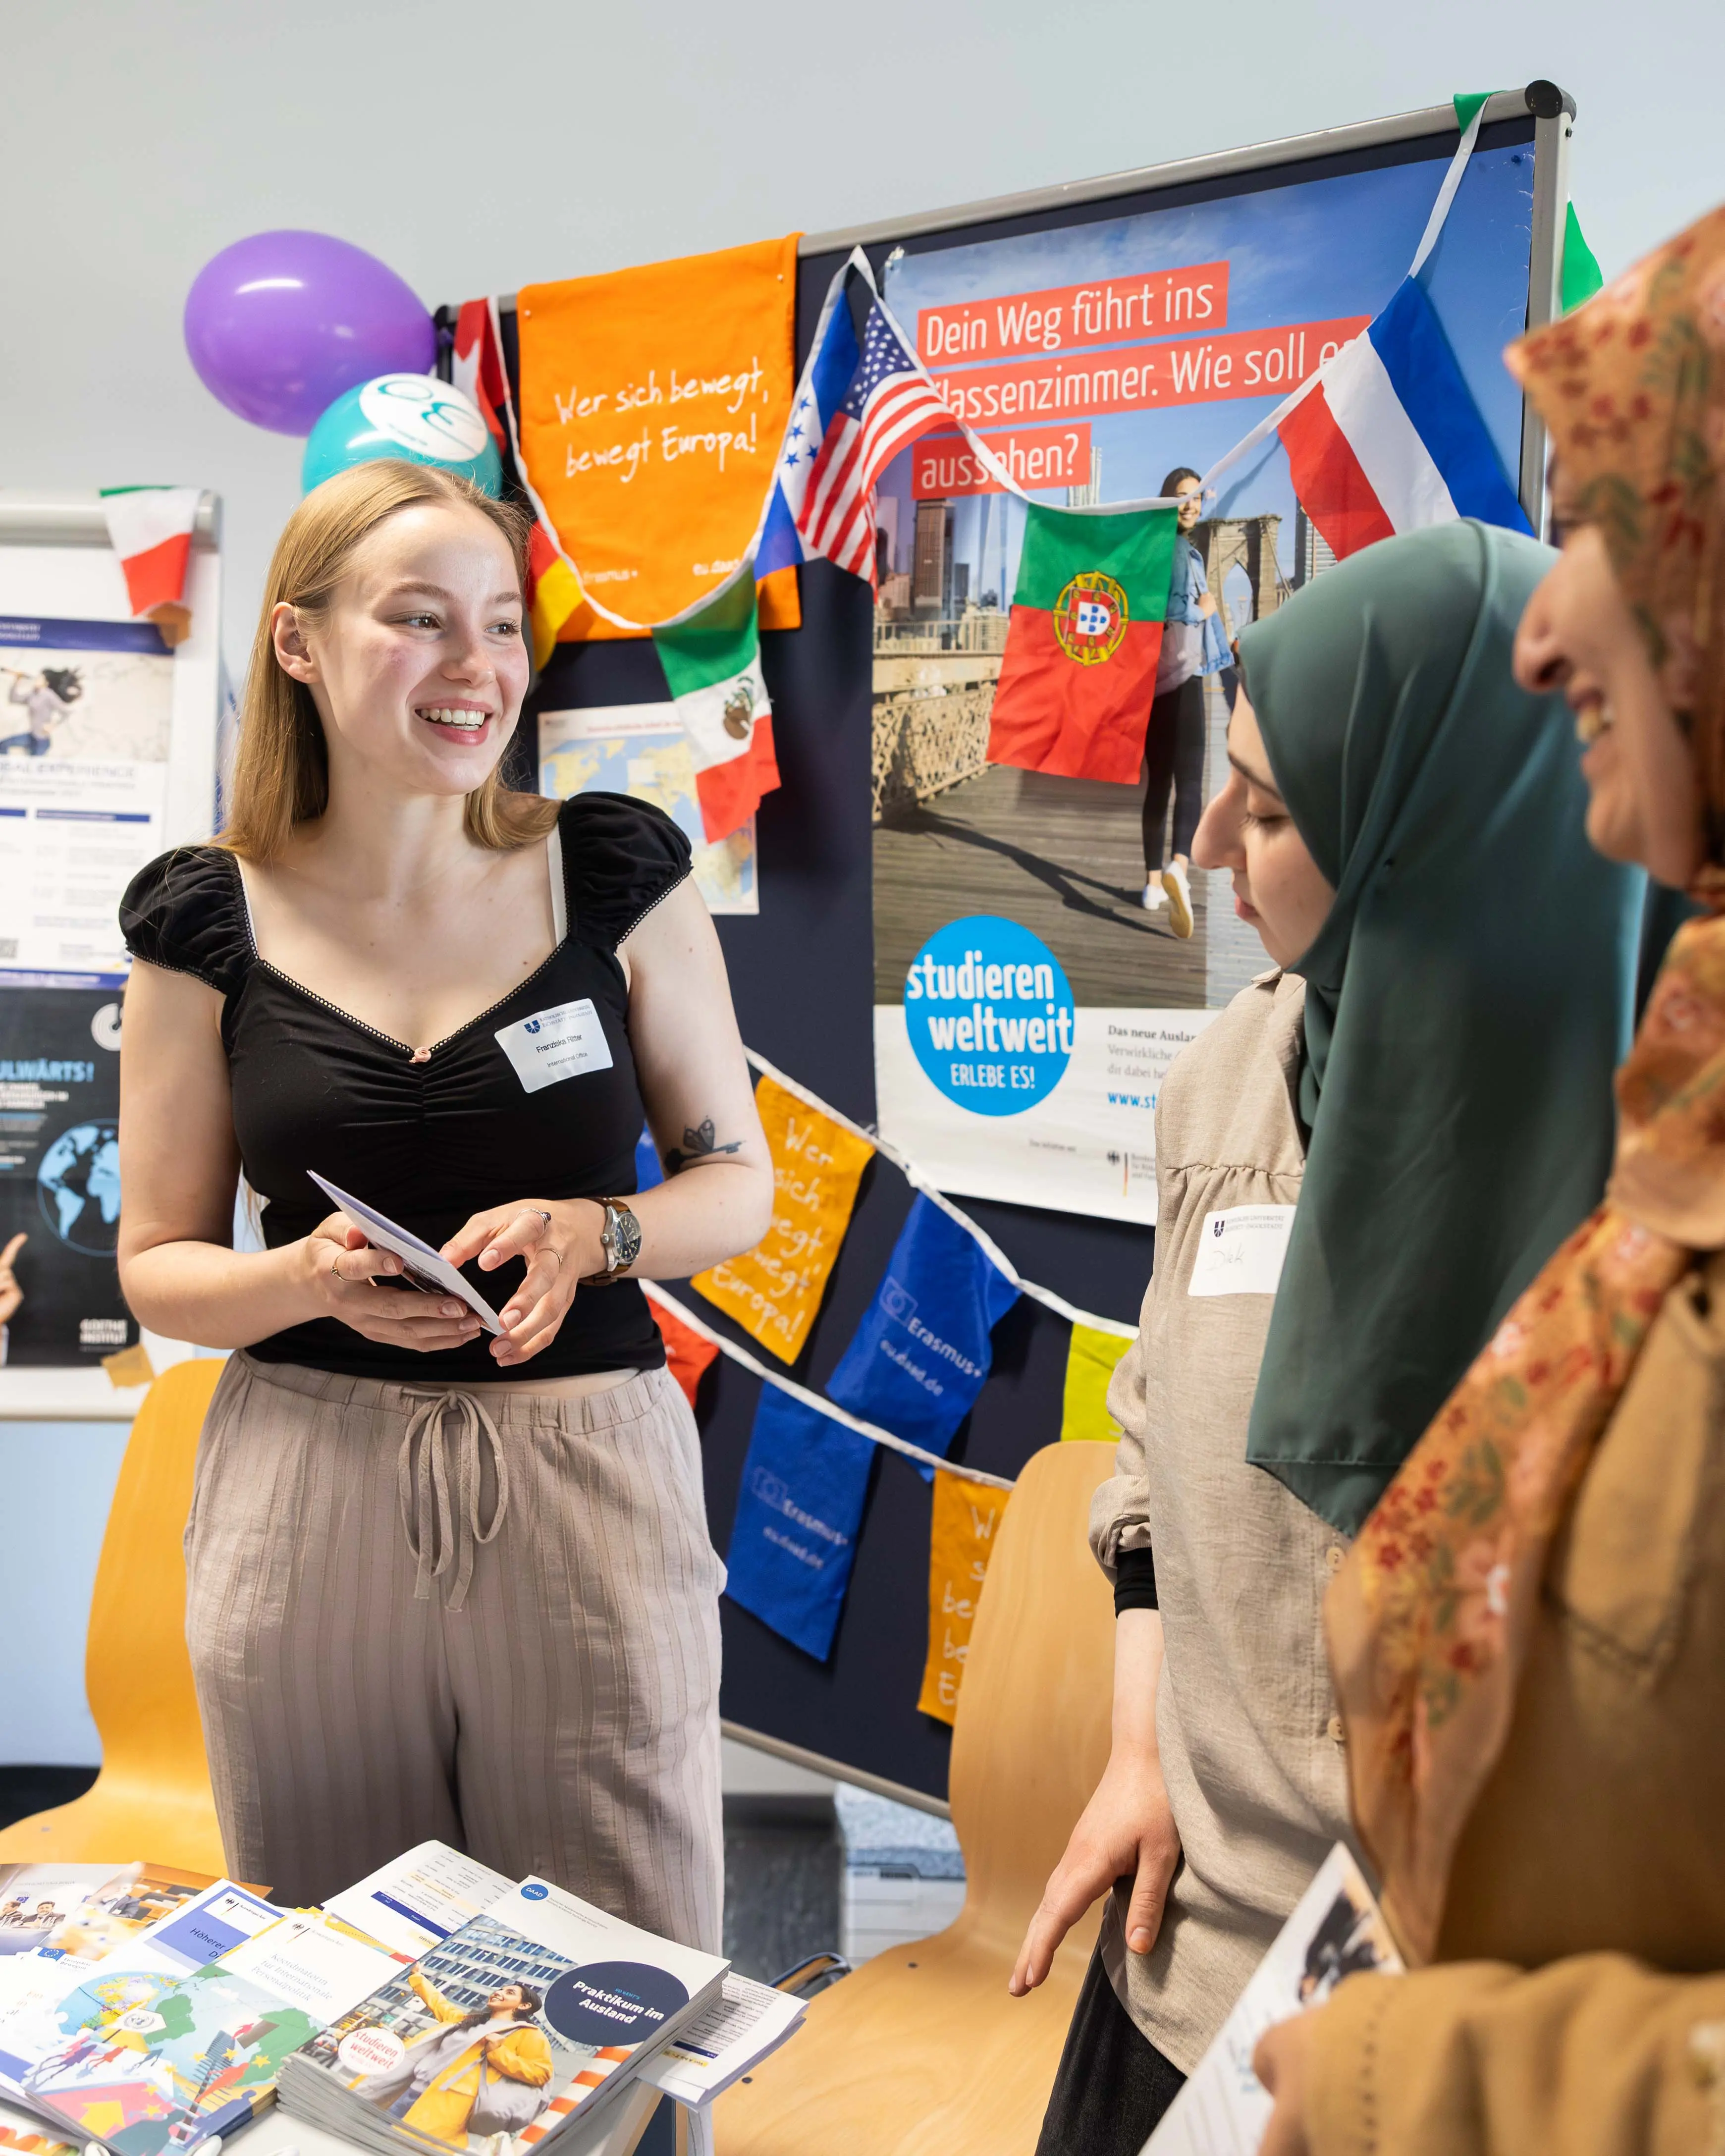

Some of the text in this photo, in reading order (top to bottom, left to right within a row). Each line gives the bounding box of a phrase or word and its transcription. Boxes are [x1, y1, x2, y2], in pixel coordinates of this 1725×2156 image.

[926, 277, 1213, 356] Dein Weg führt ins
[555, 356, 768, 425] Wer sich bewegt,
[934, 365, 1158, 420] lassenzimmer.
[1171, 345, 1232, 393] Wie
[1244, 331, 1305, 385] soll
[566, 412, 756, 483] bewegt Europa!
[907, 950, 1054, 1000] studieren
[536, 1036, 567, 1054] Franziska
[927, 1003, 1073, 1054] weltweit
[1108, 1024, 1128, 1036] Das
[1132, 1028, 1156, 1039] neue
[950, 1063, 1035, 1089] ERLEBE ES!
[785, 1117, 833, 1166] Wer
[712, 1259, 805, 1342] Europa!
[908, 1317, 982, 1378] Erasmus+
[526, 1887, 543, 1897] DAAD
[190, 1927, 226, 1949] Höherer
[573, 1981, 664, 2020] Praktikum im
[579, 1998, 637, 2024] Ausland
[350, 2043, 394, 2069] weltweit
[353, 2031, 398, 2057] studieren
